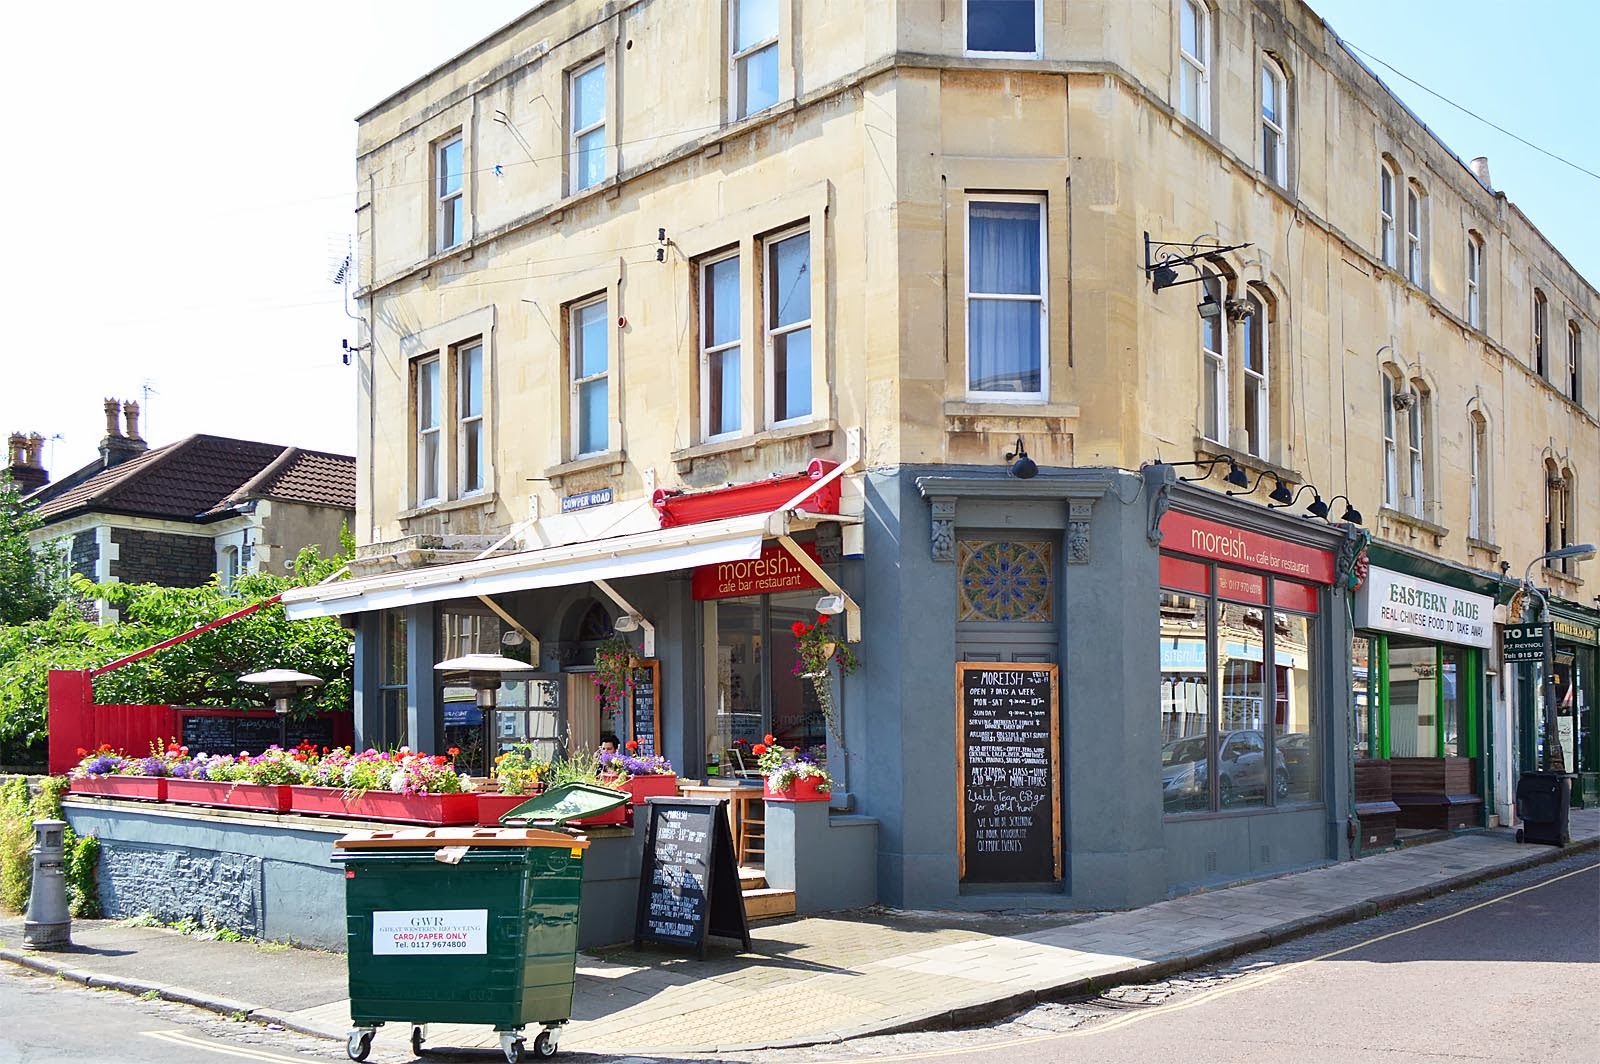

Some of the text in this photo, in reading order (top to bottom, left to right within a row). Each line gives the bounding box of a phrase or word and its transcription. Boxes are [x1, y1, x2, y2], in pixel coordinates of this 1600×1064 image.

[591, 492, 610, 504] ROAD
[1192, 529, 1310, 574] moreish... cafe bar restaurant
[718, 550, 801, 581] moreish...
[719, 574, 801, 593] cafe bar restaurant
[1390, 583, 1479, 621] EASTERN JADE
[1381, 606, 1484, 638] REAL CHINESE FOOD TO TAKE AWAY
[1504, 628, 1522, 639] TO
[1526, 627, 1543, 638] LE
[981, 671, 1024, 686] MOREISH
[973, 698, 1003, 706] MON-SAT
[967, 788, 996, 802] Watch
[998, 790, 1018, 802] Team
[1020, 789, 1033, 802] GB
[993, 802, 1013, 815] gold
[411, 917, 444, 926] GWR
